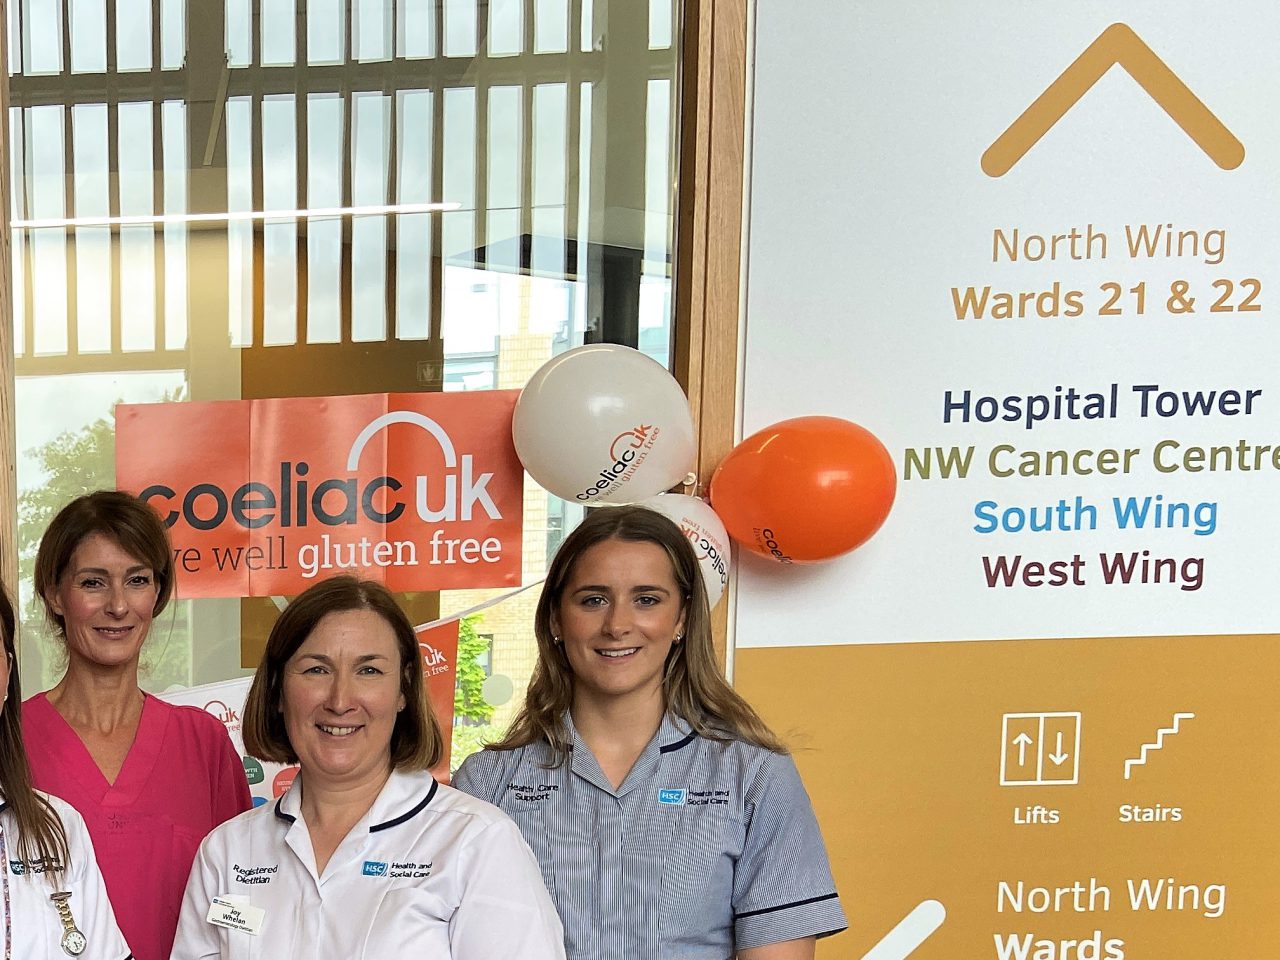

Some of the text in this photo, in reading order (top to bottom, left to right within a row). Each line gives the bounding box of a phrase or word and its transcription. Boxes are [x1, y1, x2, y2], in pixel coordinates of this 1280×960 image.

[992, 223, 1227, 264] North Wing
[951, 278, 1262, 320] Wards 21 & 22
[943, 384, 1262, 429] Hospital Tower
[577, 424, 652, 500] coeliac uk
[903, 446, 975, 480] NW
[988, 443, 1140, 479] Cancer
[417, 454, 503, 523] uk
[973, 493, 1218, 535] South Wing
[212, 529, 502, 579] well gluten free
[982, 551, 1204, 592] West Wing
[425, 649, 447, 667] uk
[507, 783, 559, 793] Health Care
[515, 792, 550, 801] Support
[661, 792, 680, 800] HSC
[715, 789, 729, 797] and
[687, 798, 729, 806] Social Care
[1013, 806, 1060, 824] Lifts
[1118, 804, 1182, 822] Stairs
[233, 864, 278, 877] Registered
[366, 864, 383, 873] HSC
[419, 861, 432, 869] and
[236, 875, 270, 885] Dietitian
[996, 878, 1226, 917] North Wing
[223, 913, 246, 925] Whelan
[231, 909, 241, 918] Joy
